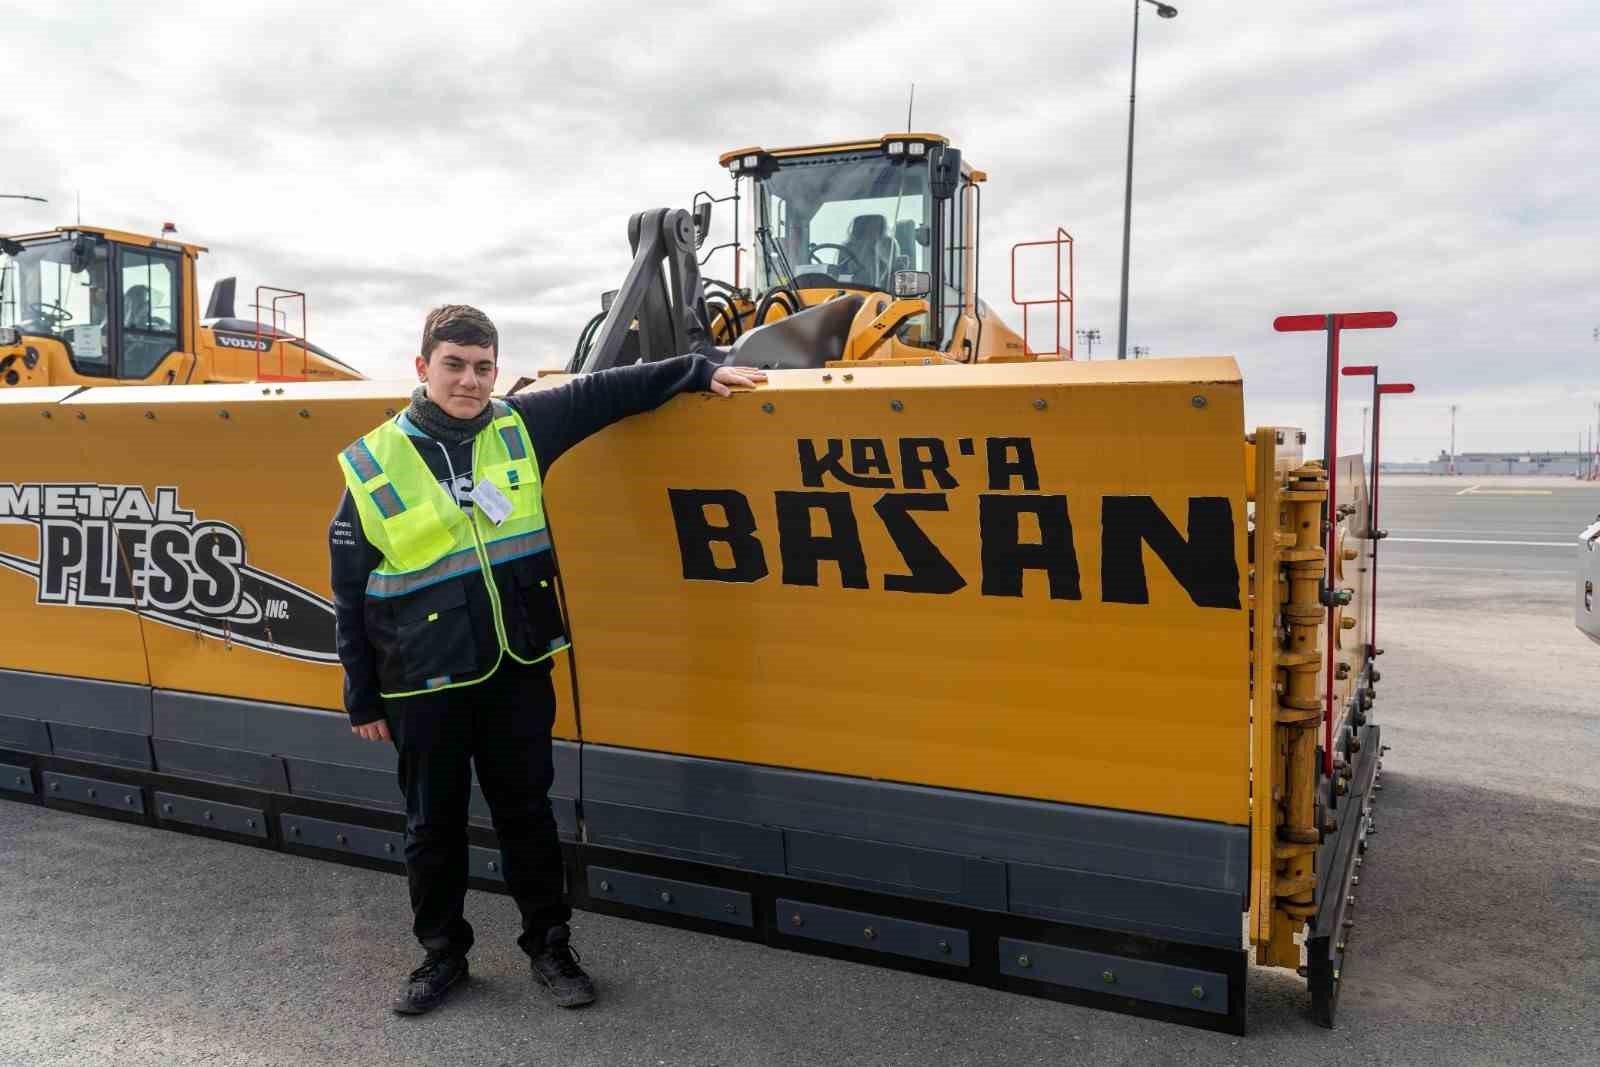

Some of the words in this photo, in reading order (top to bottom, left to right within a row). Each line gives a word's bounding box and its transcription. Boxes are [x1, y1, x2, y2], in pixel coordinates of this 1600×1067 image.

[218, 337, 267, 350] VOLVO
[797, 437, 1041, 491] KAR'A
[0, 485, 193, 523] METAL
[42, 520, 241, 615] PLESS
[667, 487, 1242, 610] BASAN
[265, 599, 290, 619] INC.
